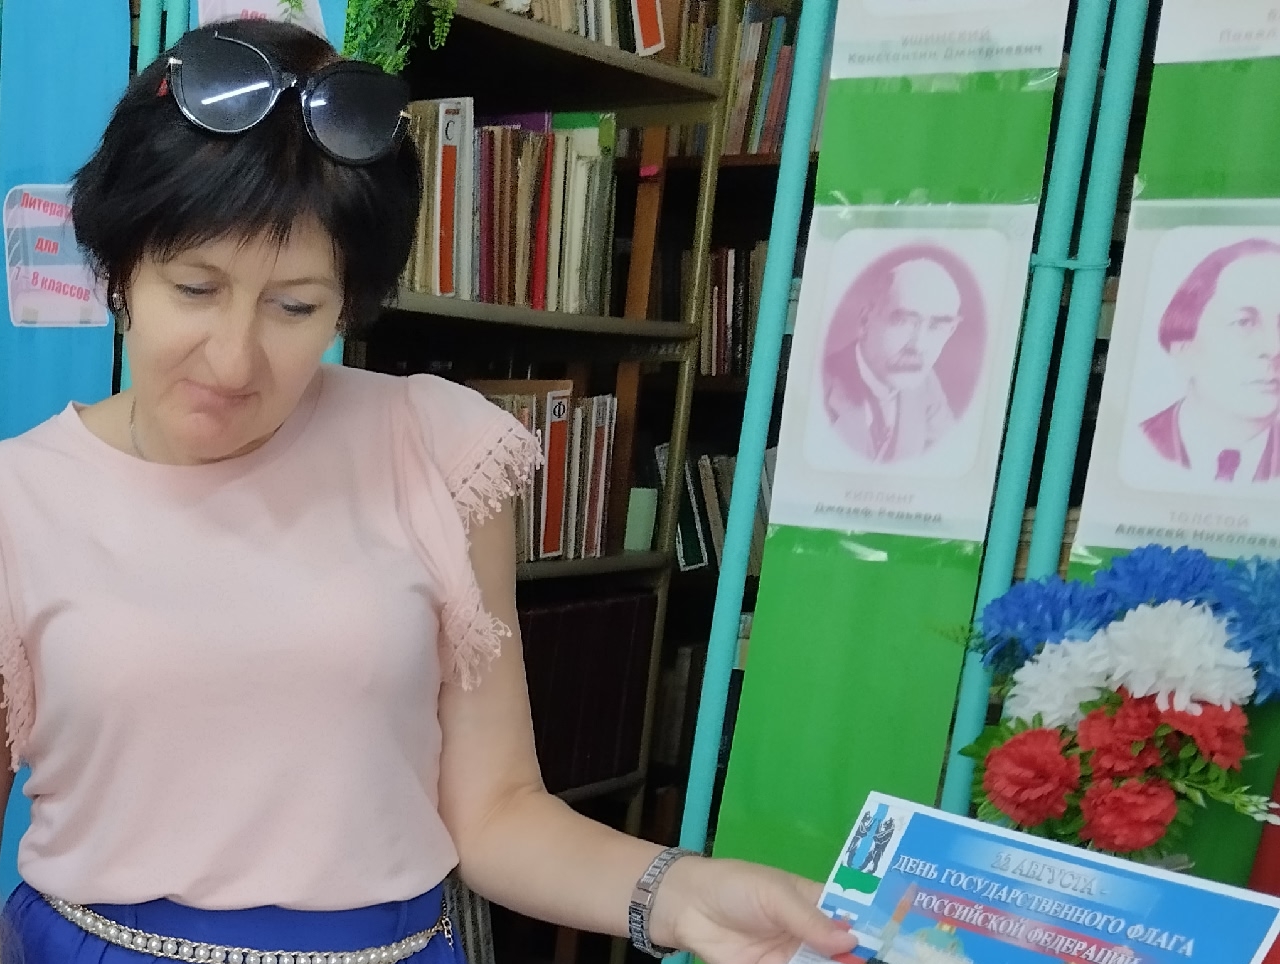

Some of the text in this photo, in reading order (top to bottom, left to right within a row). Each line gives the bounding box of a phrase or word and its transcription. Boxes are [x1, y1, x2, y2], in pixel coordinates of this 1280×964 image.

[848, 44, 1043, 64] Константин Дмитриевич
[34, 237, 59, 255] для
[41, 276, 91, 302] классов
[553, 401, 565, 418] Ф
[1170, 511, 1249, 529] ТОЛСТОЙ
[1115, 524, 1185, 540] Алексей
[990, 851, 1012, 871] 22
[1013, 857, 1096, 896] АВГУСТА
[892, 855, 1196, 958] ДЕНЬ ГОСУДАРСТВЕННОГО ФЛАГА
[913, 891, 1026, 940] РОССИЙСКОЙ
